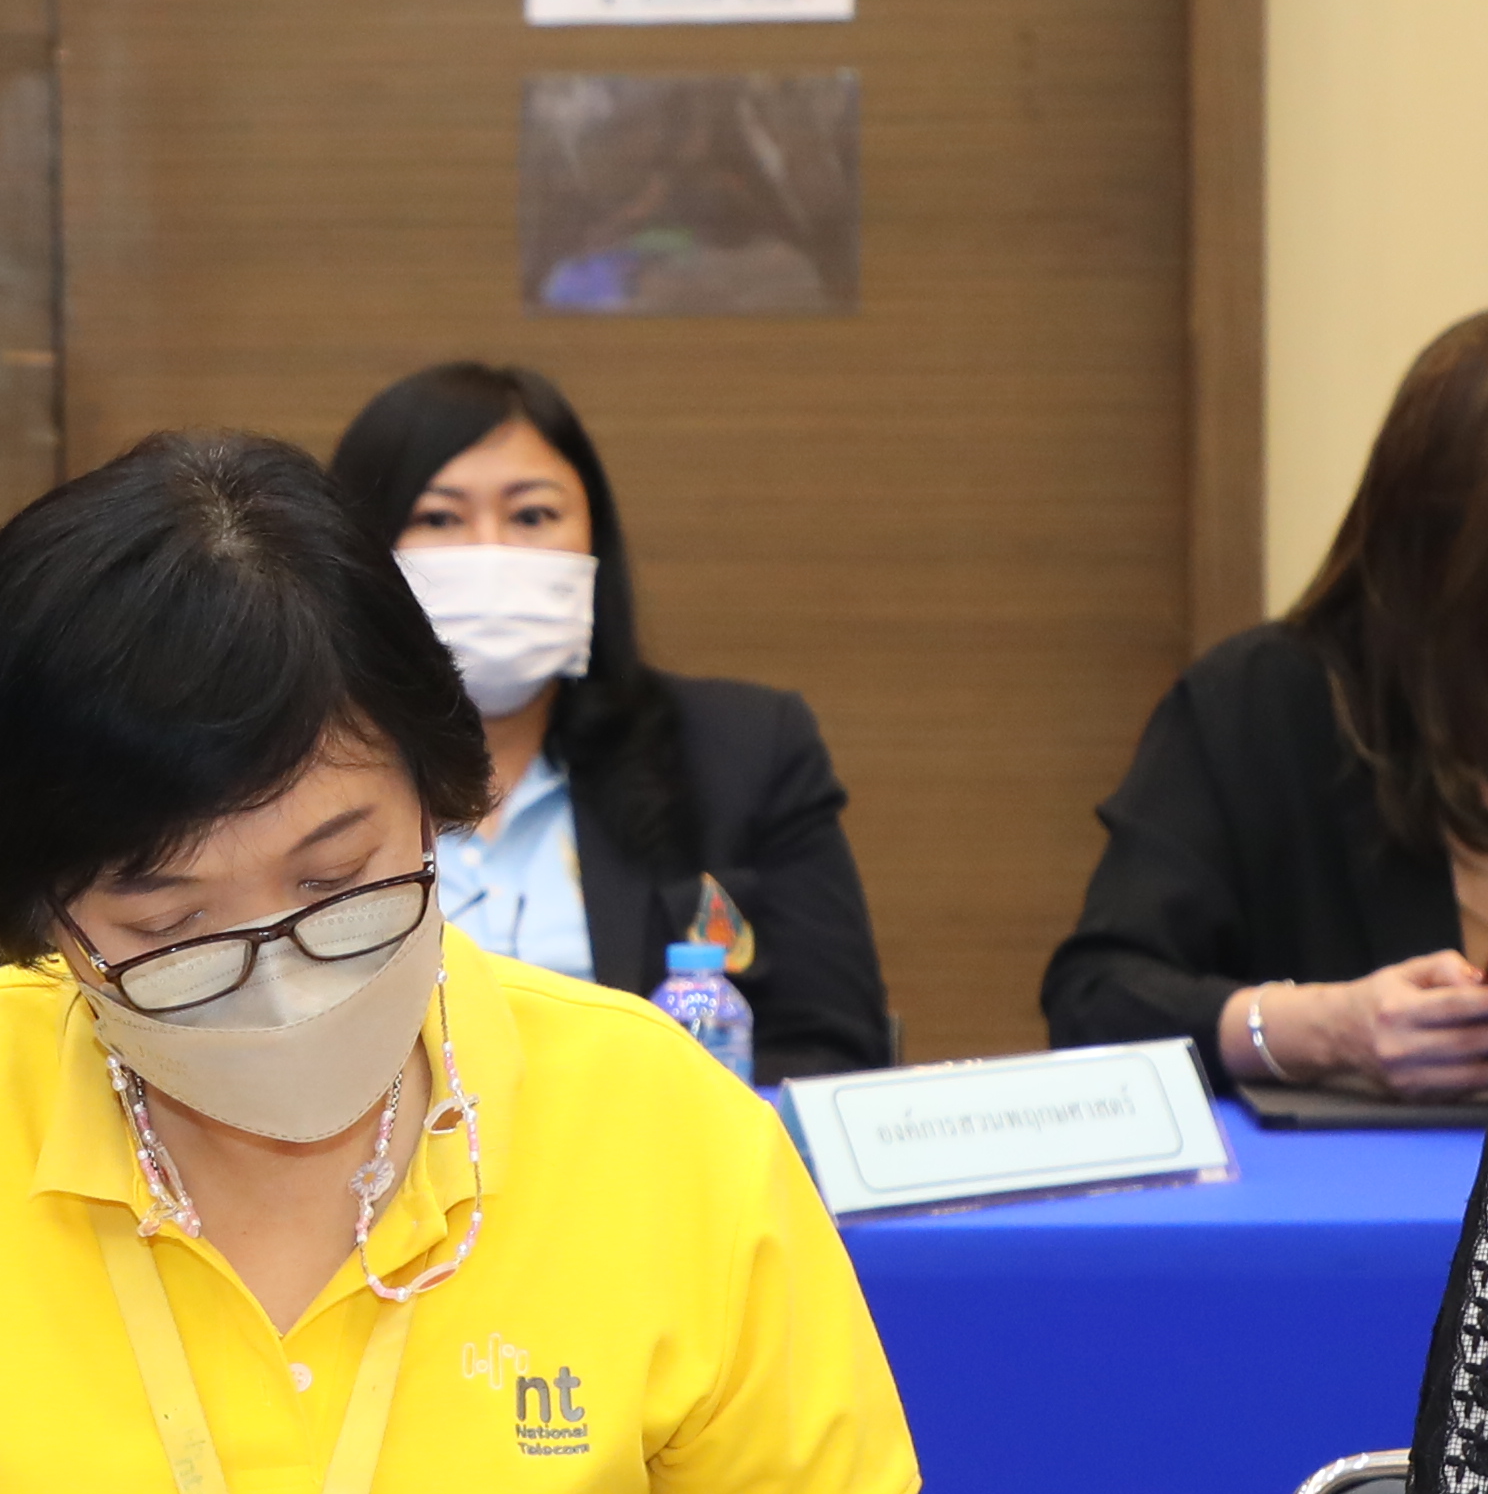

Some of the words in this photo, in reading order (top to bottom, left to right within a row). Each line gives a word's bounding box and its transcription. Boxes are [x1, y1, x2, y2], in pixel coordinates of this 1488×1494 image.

[516, 1365, 585, 1424] nt
[515, 1423, 589, 1439] National
[517, 1441, 591, 1456] Telecom
